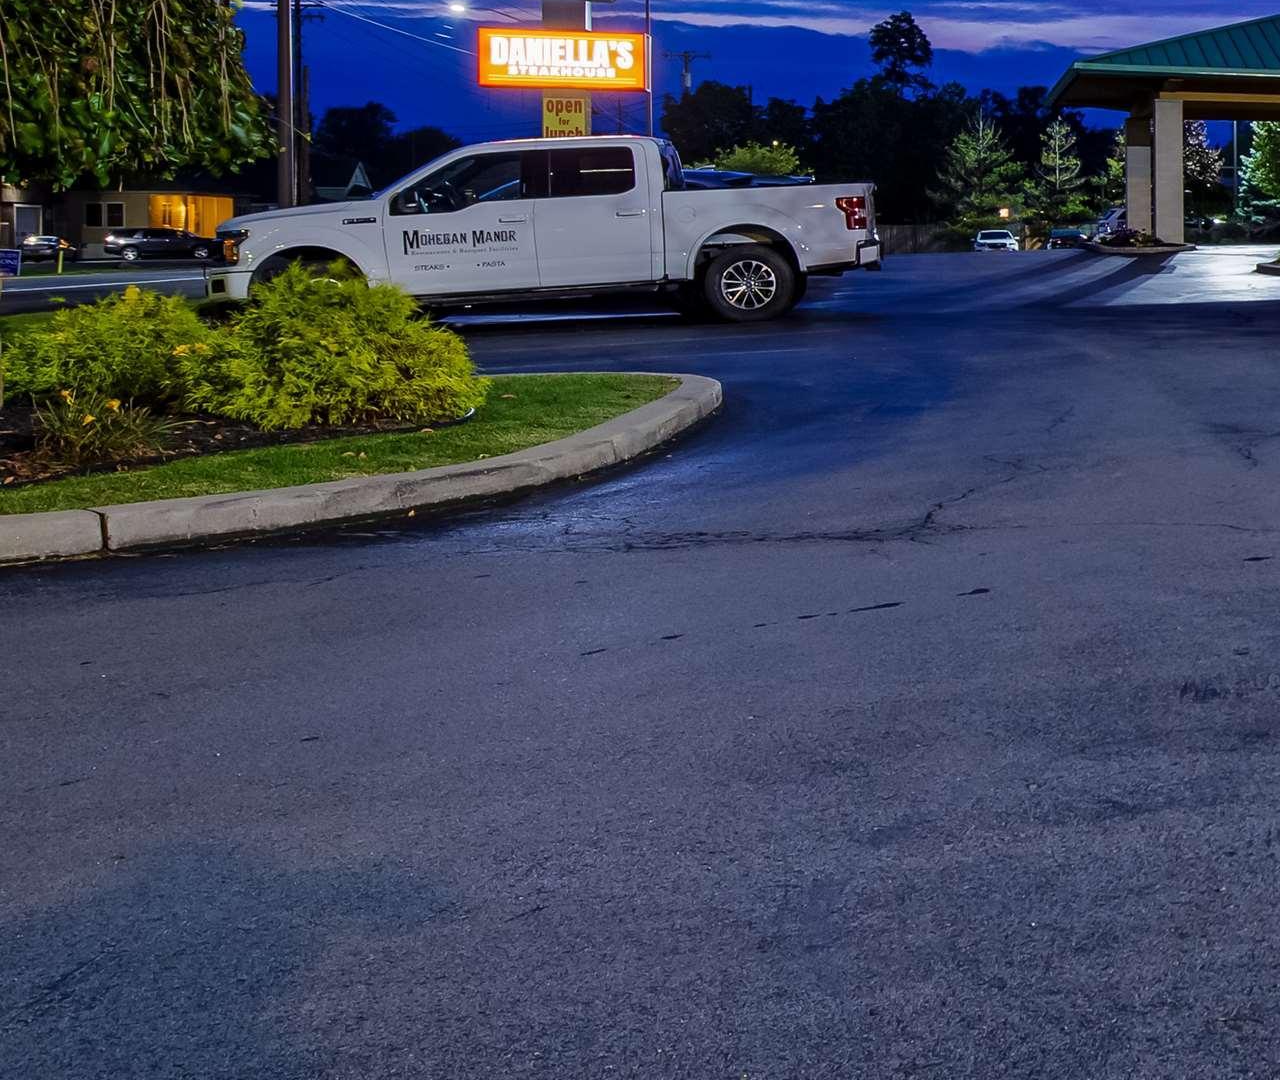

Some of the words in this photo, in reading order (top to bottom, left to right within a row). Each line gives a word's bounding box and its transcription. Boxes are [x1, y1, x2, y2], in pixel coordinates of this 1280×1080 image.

[490, 36, 634, 69] DANIELLA'S
[508, 65, 616, 78] STEAKHOUSE
[546, 100, 583, 116] open
[472, 230, 517, 248] MANOR
